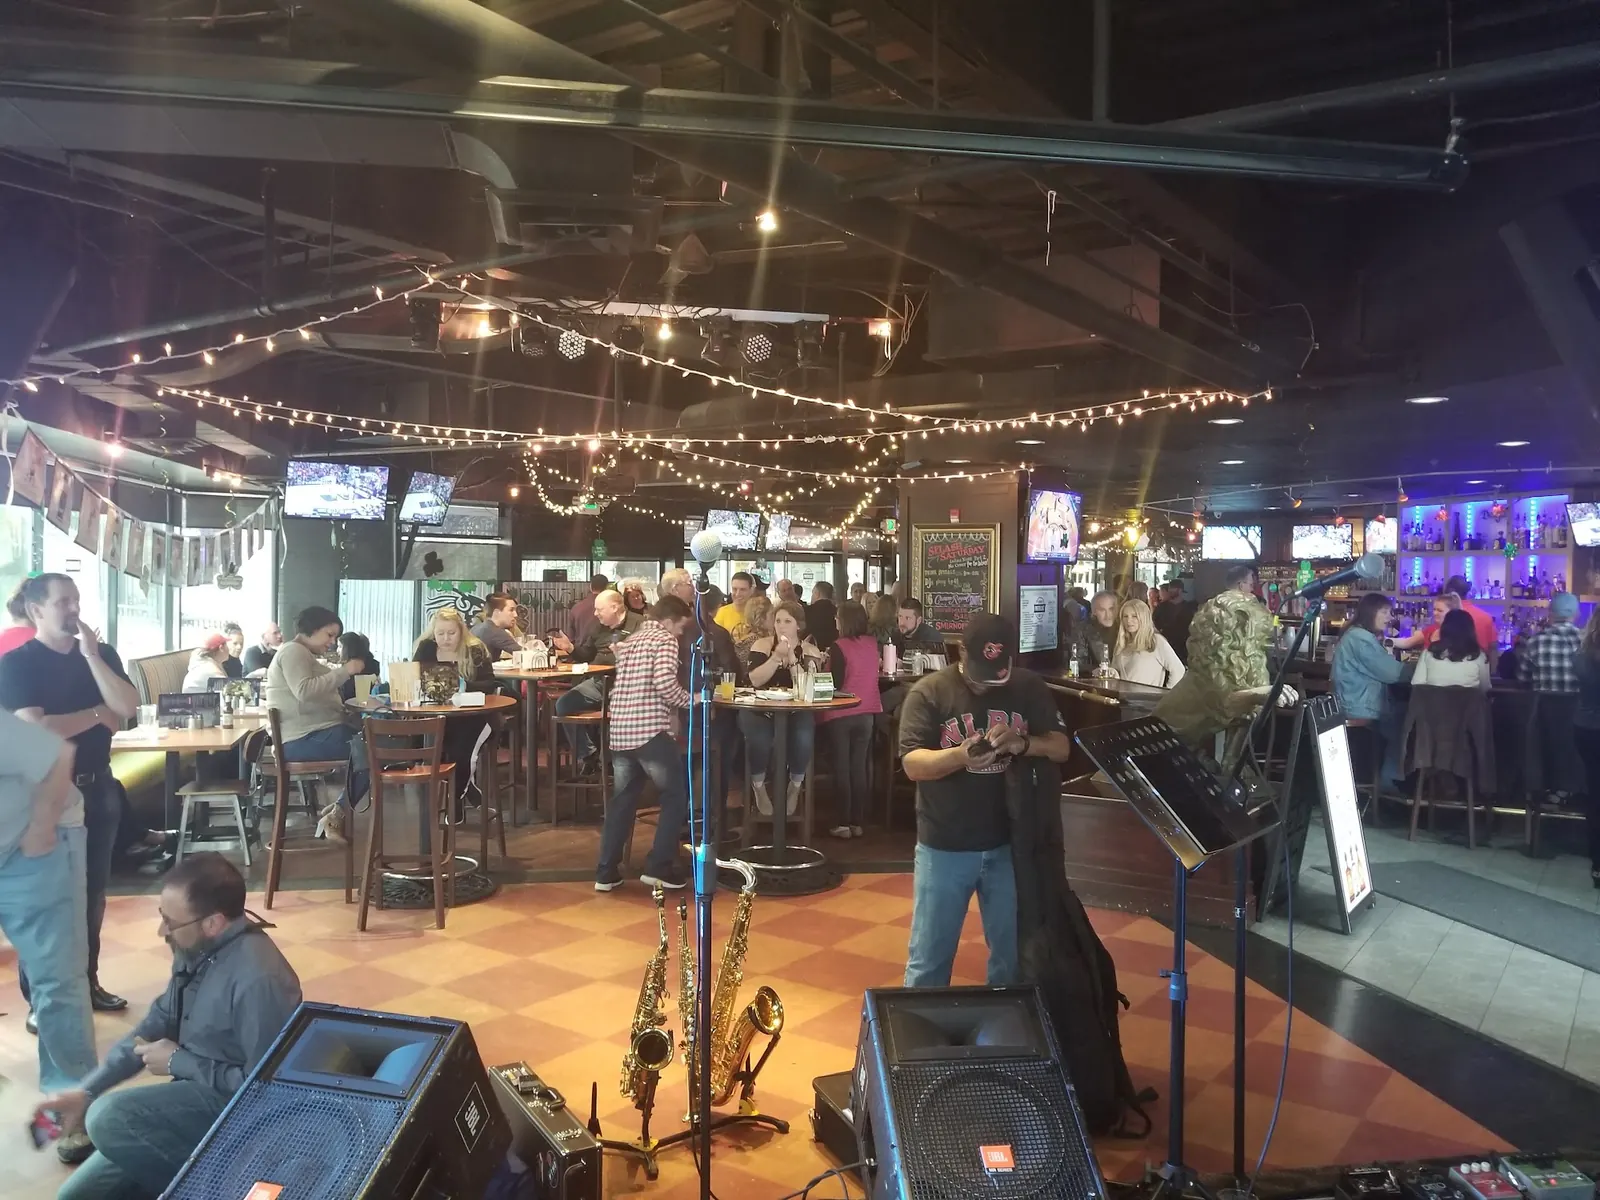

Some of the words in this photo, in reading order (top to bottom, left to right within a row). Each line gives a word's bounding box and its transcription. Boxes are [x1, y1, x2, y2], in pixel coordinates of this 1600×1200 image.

[940, 546, 985, 561] SATURDAY
[465, 1100, 480, 1136] JBL
[986, 1151, 1009, 1162] JBL
